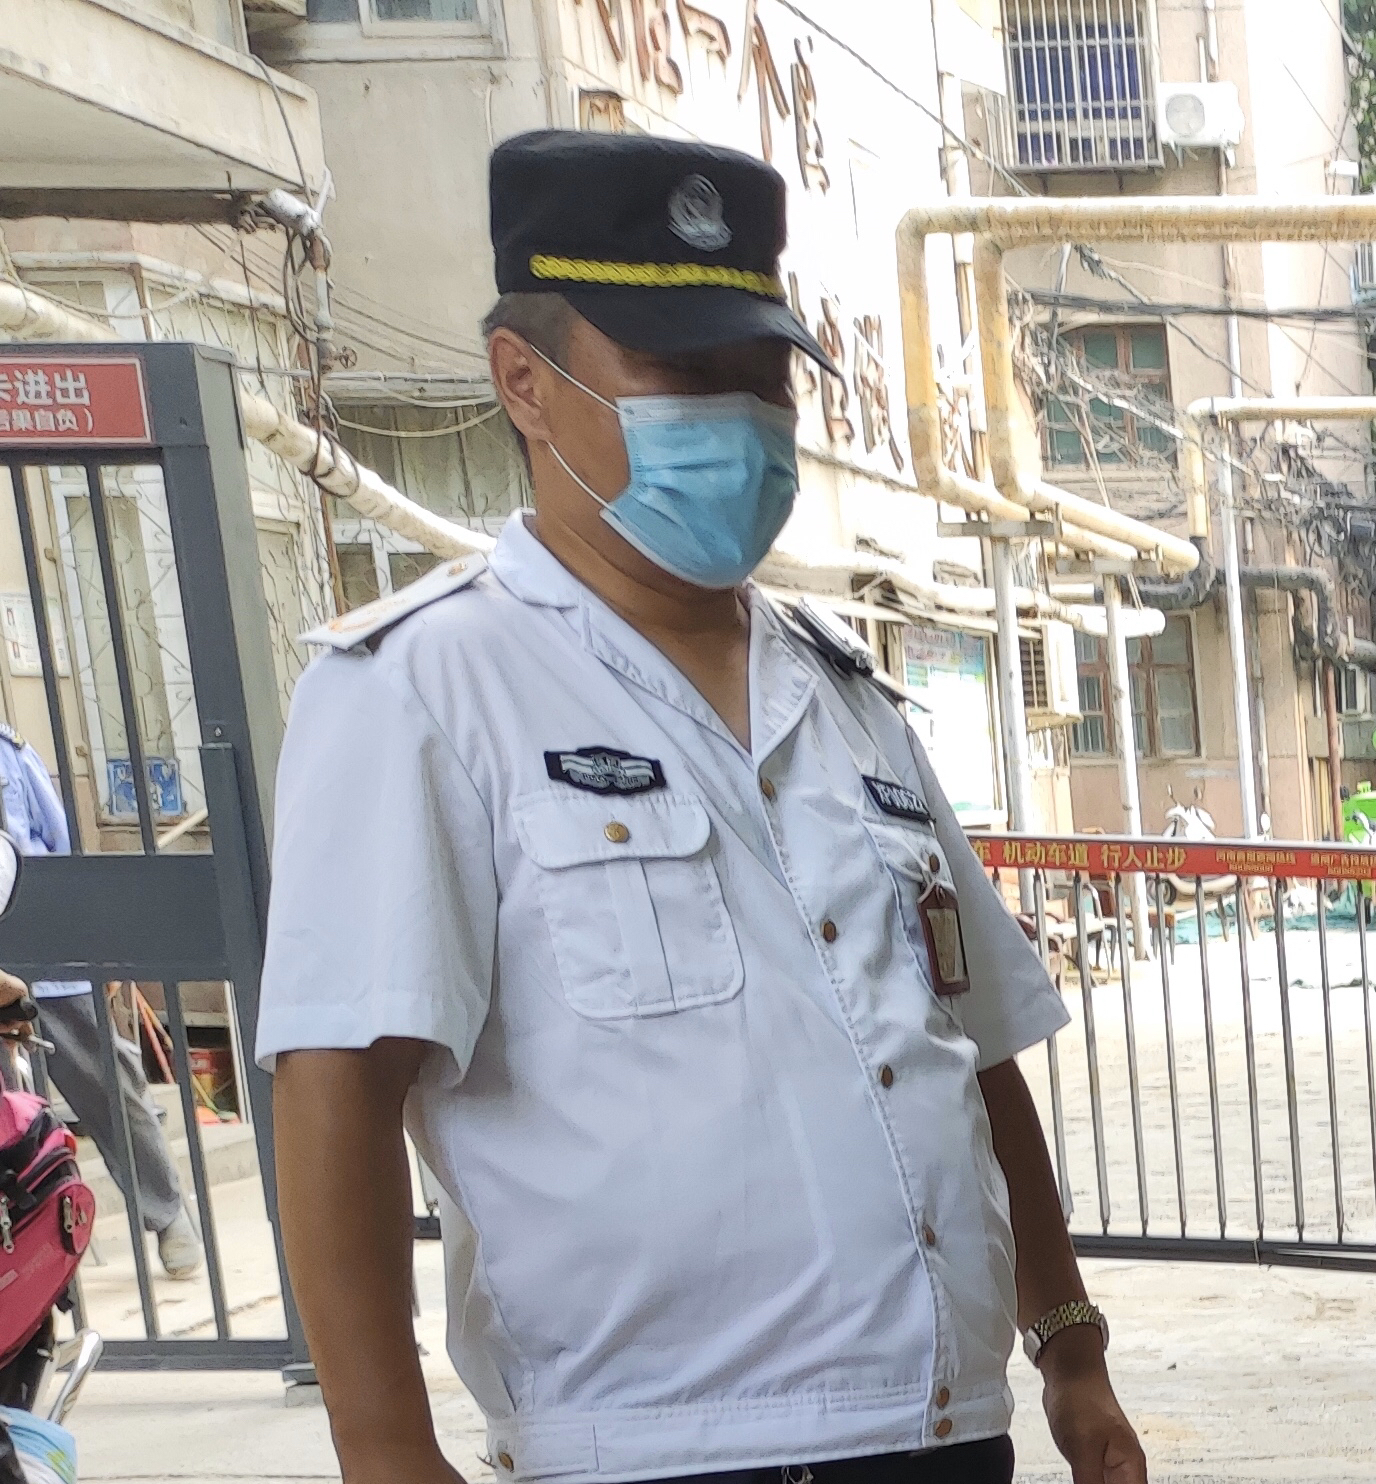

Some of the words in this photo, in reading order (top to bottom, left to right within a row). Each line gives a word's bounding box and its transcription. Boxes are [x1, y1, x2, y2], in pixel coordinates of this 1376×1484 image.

[1003, 840, 1090, 868] 机动车道
[1101, 844, 1186, 871] 行人止步
